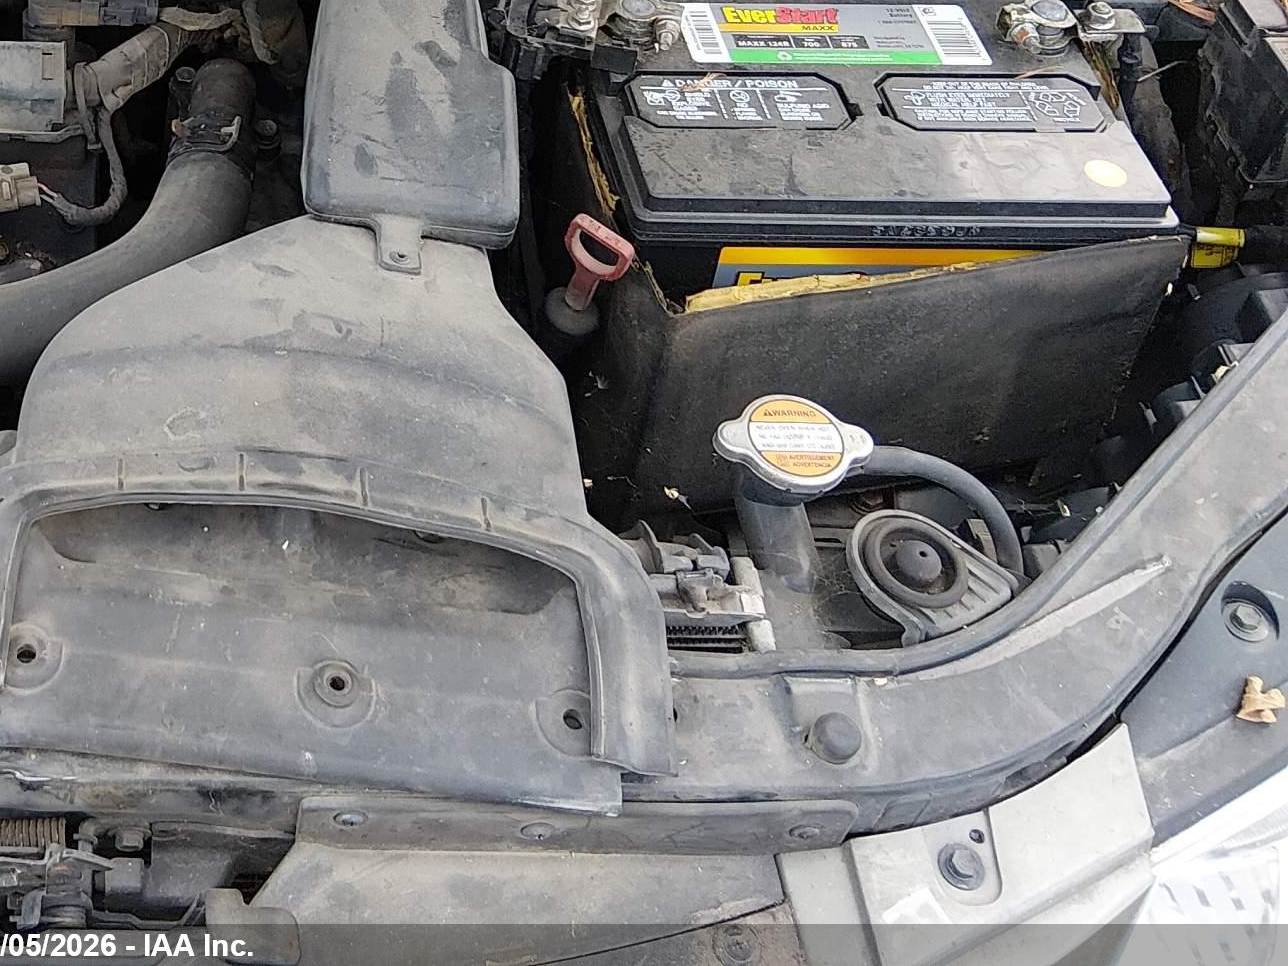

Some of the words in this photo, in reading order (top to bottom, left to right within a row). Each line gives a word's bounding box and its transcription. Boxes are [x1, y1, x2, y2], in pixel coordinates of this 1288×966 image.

[721, 7, 839, 25] EverStart
[767, 40, 790, 48] 124R
[745, 80, 799, 88] POISON
[773, 409, 817, 418] WARNING
